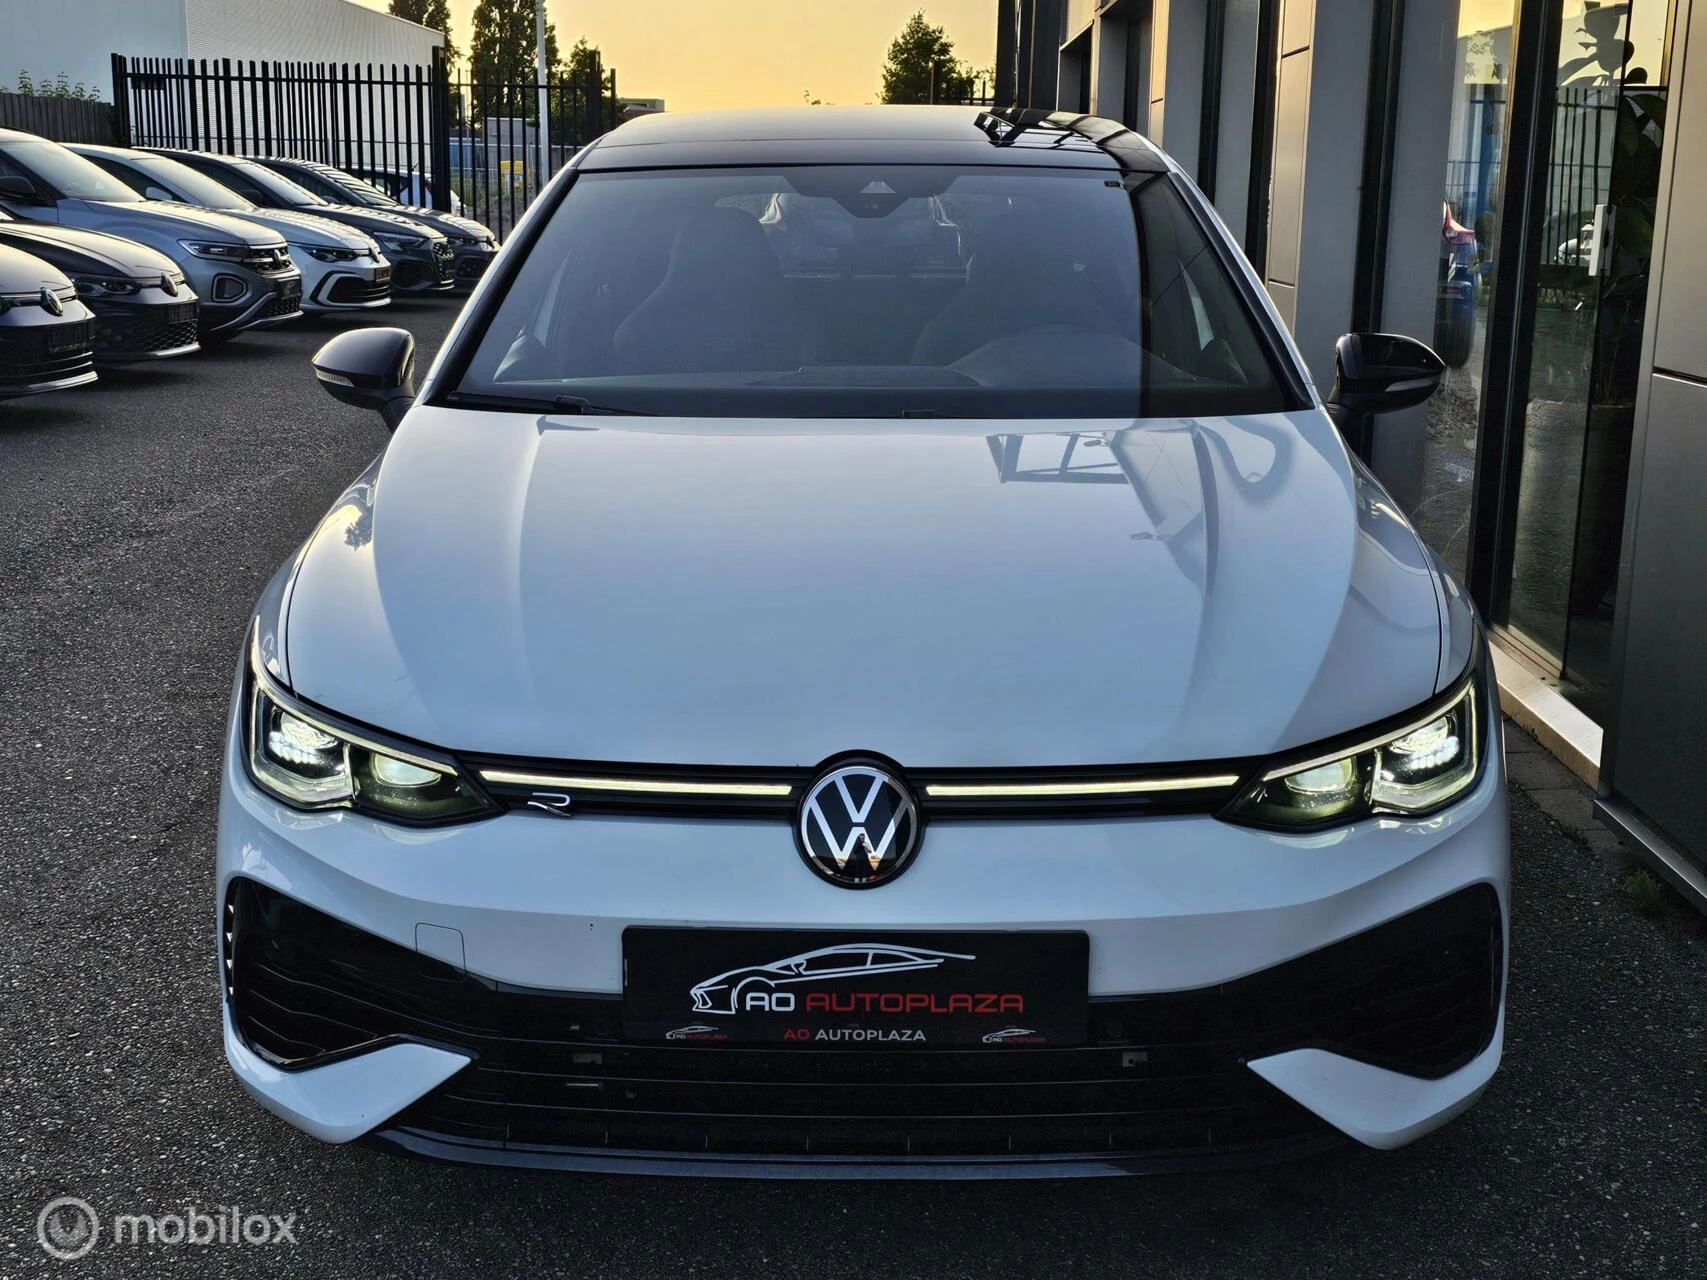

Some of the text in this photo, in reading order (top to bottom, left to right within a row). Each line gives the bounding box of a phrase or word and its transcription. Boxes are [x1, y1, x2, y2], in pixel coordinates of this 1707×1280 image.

[801, 766, 917, 883] VW
[746, 992, 1024, 1013] AO AUTOPLAZA
[784, 1028, 927, 1041] AO AUTOPLAZA
